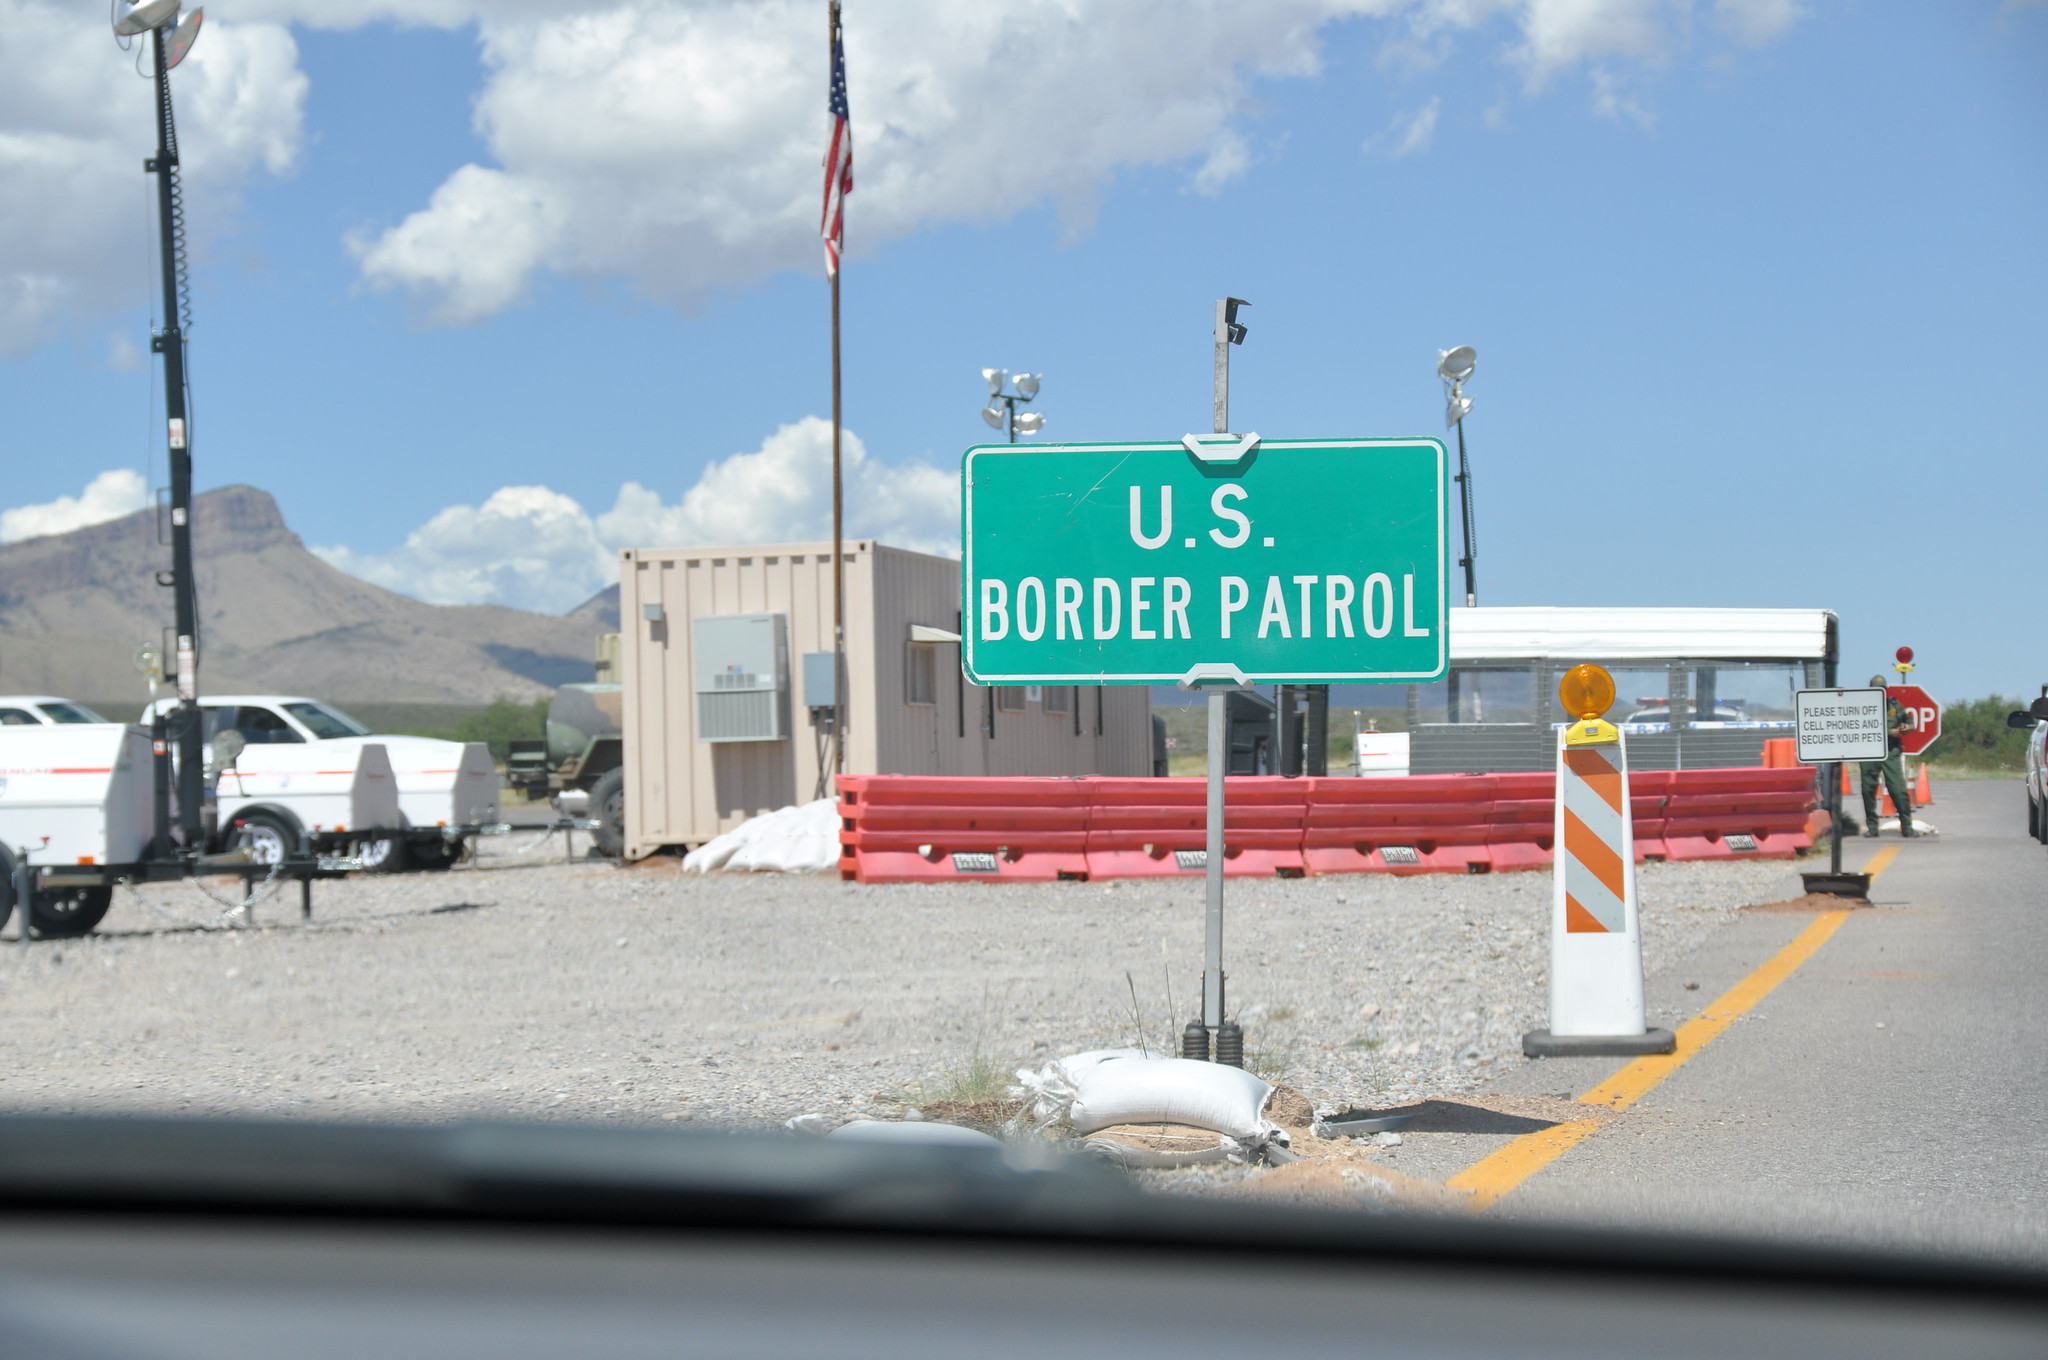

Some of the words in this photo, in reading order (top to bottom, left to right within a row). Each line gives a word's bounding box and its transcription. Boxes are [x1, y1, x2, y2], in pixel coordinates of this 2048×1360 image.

[1129, 483, 1275, 550] U.S.
[981, 576, 1192, 642] BORDER
[1220, 572, 1430, 639] PATROL
[1804, 706, 1836, 717] PLEASE
[1838, 706, 1860, 716] TURN
[1862, 705, 1878, 716] OFF
[1905, 706, 1935, 732] OP
[1803, 721, 1824, 731] CELL
[1826, 720, 1860, 730] PHONES
[1801, 734, 1835, 745] SECURE
[1837, 733, 1859, 743] YOUR
[1862, 732, 1882, 743] PETS
[1175, 850, 1207, 860] TRITO
[1380, 846, 1415, 855] TRITON
[952, 852, 995, 862] TRITON
[957, 860, 997, 869] BARRIER
